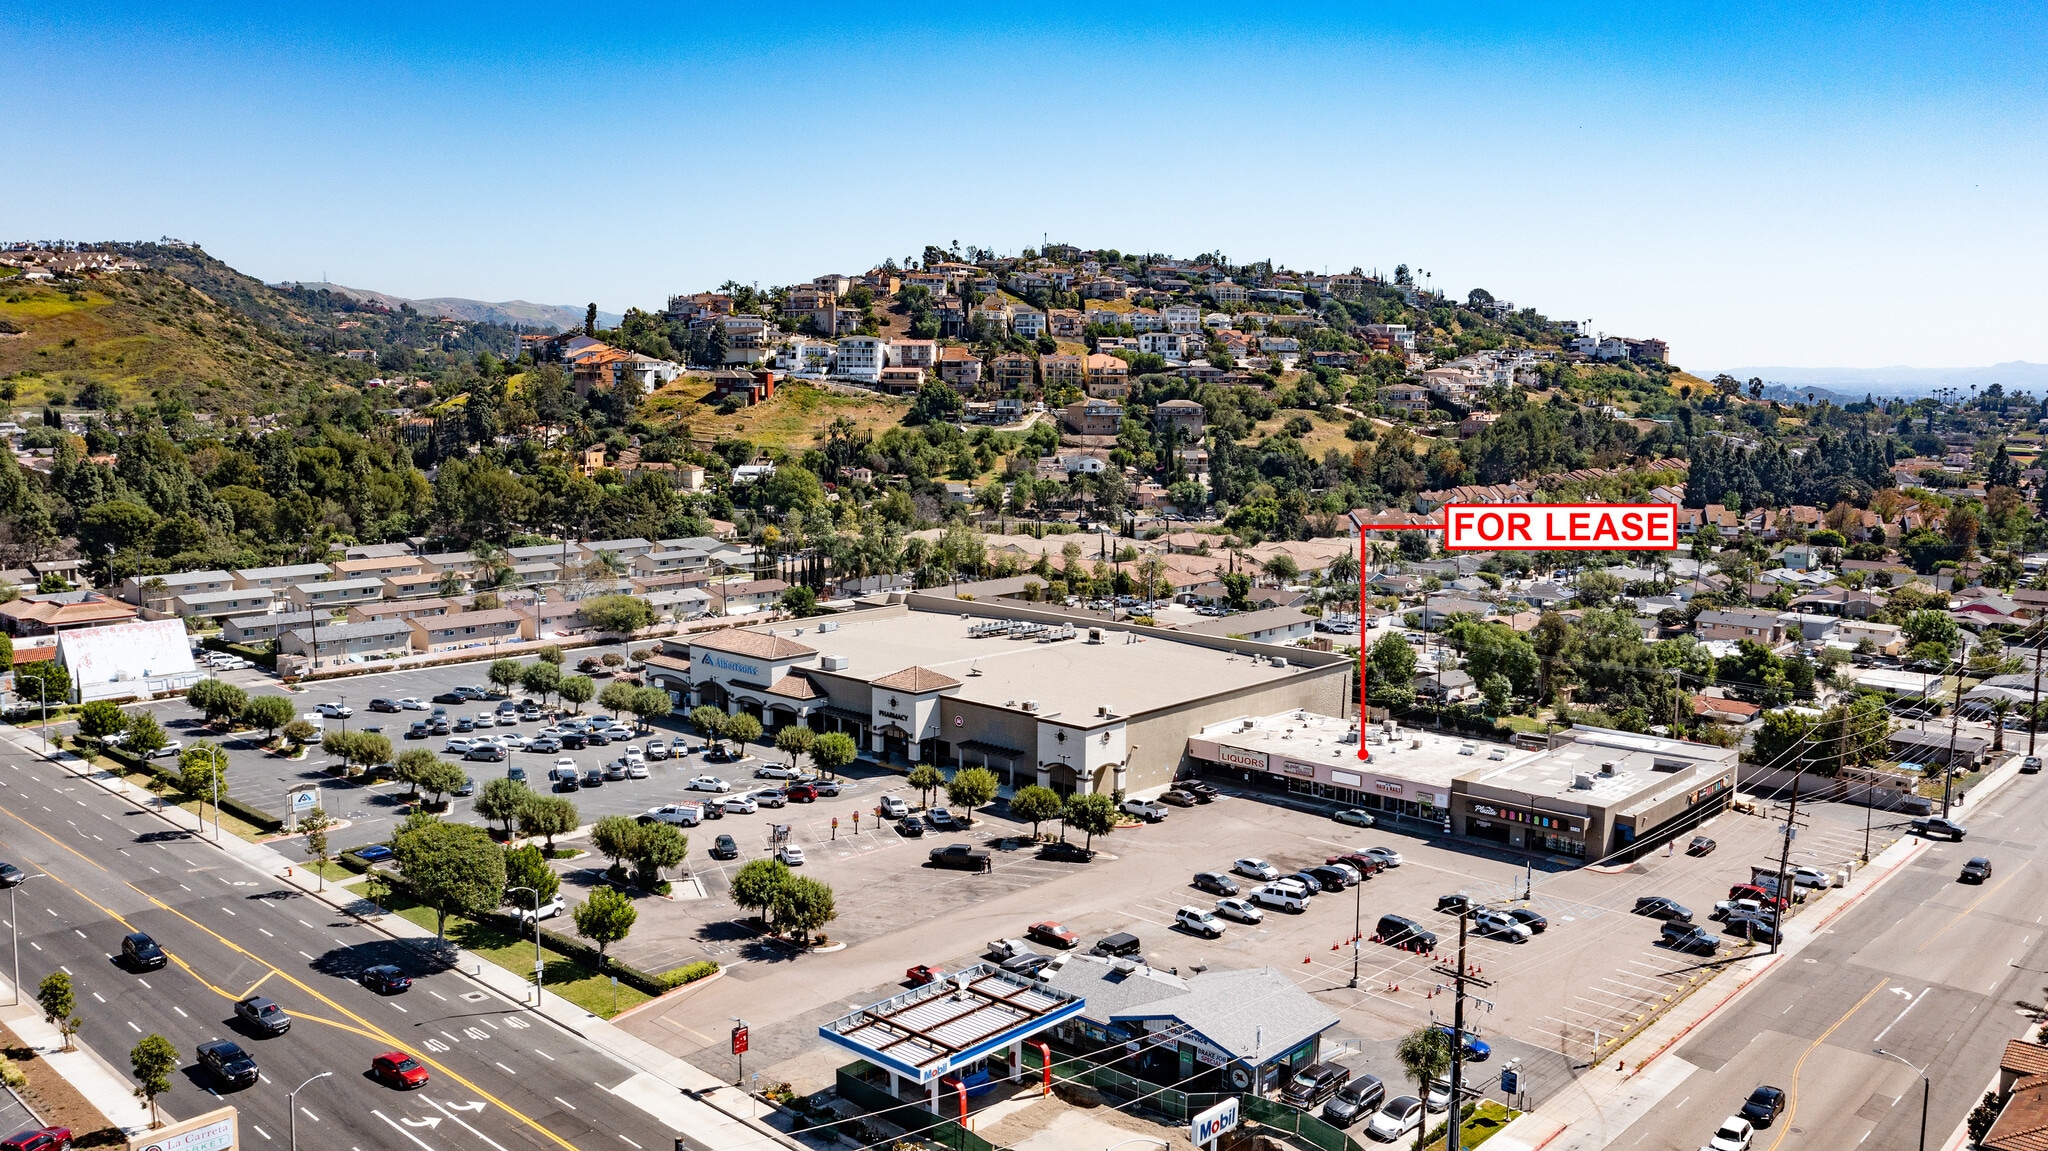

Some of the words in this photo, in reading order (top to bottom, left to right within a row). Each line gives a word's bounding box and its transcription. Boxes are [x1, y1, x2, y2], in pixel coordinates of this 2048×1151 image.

[715, 657, 759, 675] Albertsons
[879, 709, 908, 722] PHARMACY
[1221, 753, 1265, 768] LIQUORS
[503, 1016, 531, 1029] 40
[463, 1026, 491, 1040] 40
[423, 1038, 450, 1053] 40
[1198, 1048, 1215, 1058] BRAKE
[1216, 1054, 1226, 1062] JOB
[923, 1062, 948, 1080] Mobil
[1200, 1107, 1236, 1141] Mobil
[167, 1140, 181, 1150] La
[185, 1125, 228, 1143] Carreta
